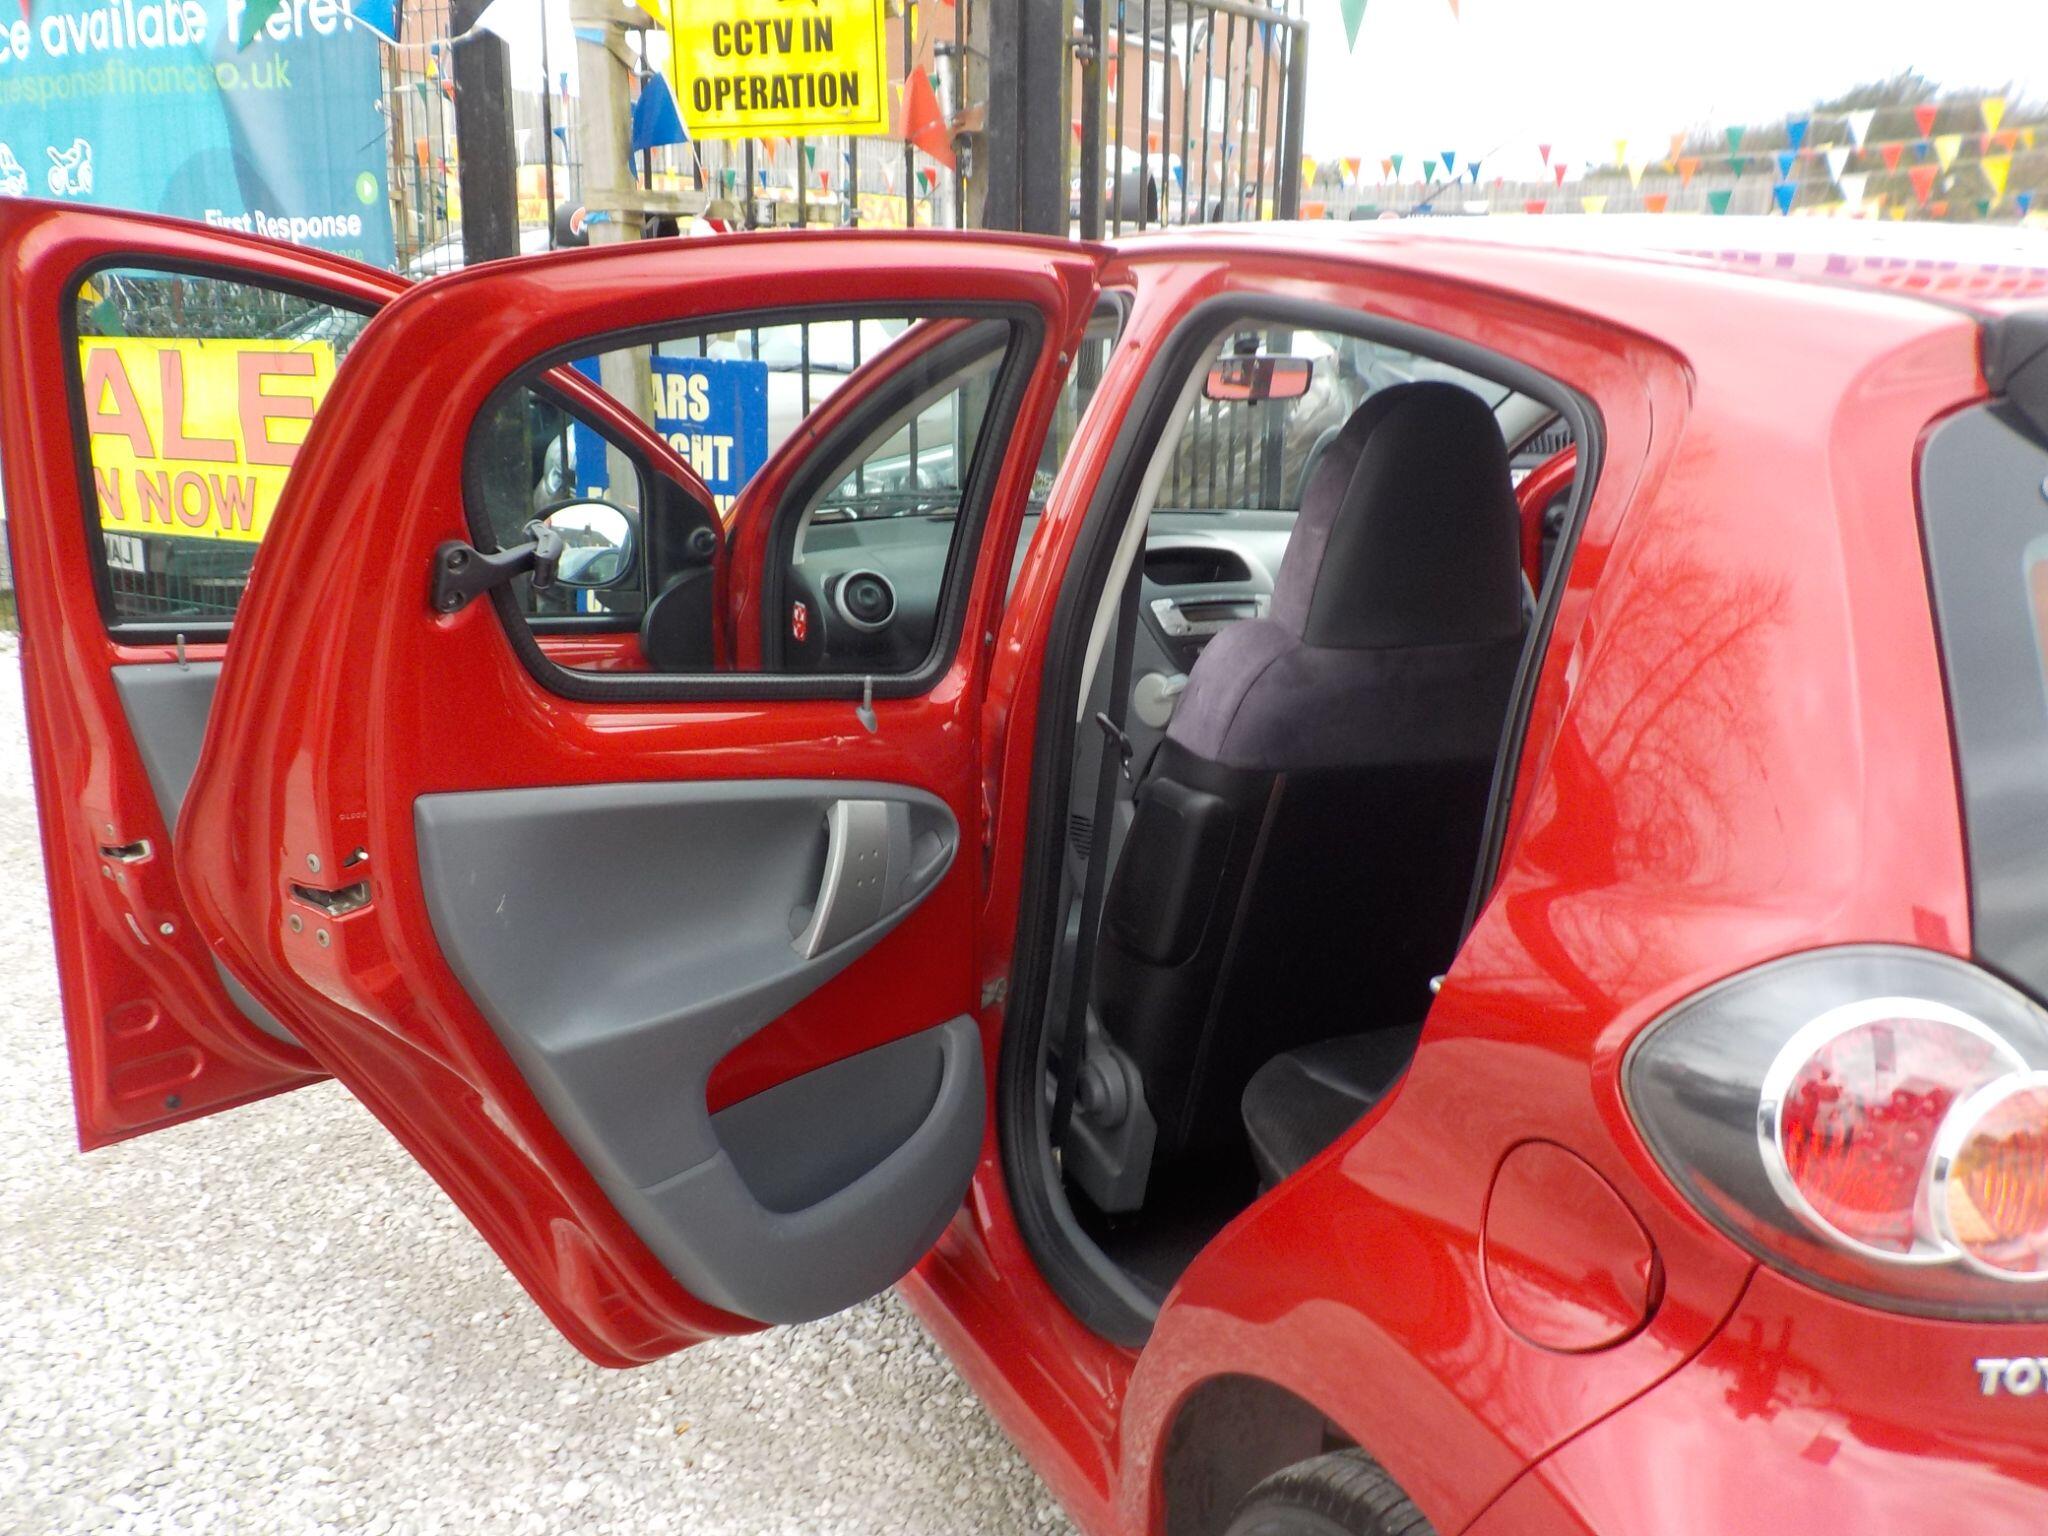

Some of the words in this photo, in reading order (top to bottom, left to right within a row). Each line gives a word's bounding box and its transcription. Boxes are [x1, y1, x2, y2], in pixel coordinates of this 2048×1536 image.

[40, 0, 208, 58] availabe
[712, 18, 793, 57] CCTV
[802, 16, 834, 52] IN
[693, 71, 859, 112] OPERATION
[205, 209, 252, 232] First
[255, 210, 361, 244] Response
[659, 433, 734, 481] GHT
[135, 470, 256, 531] NOW
